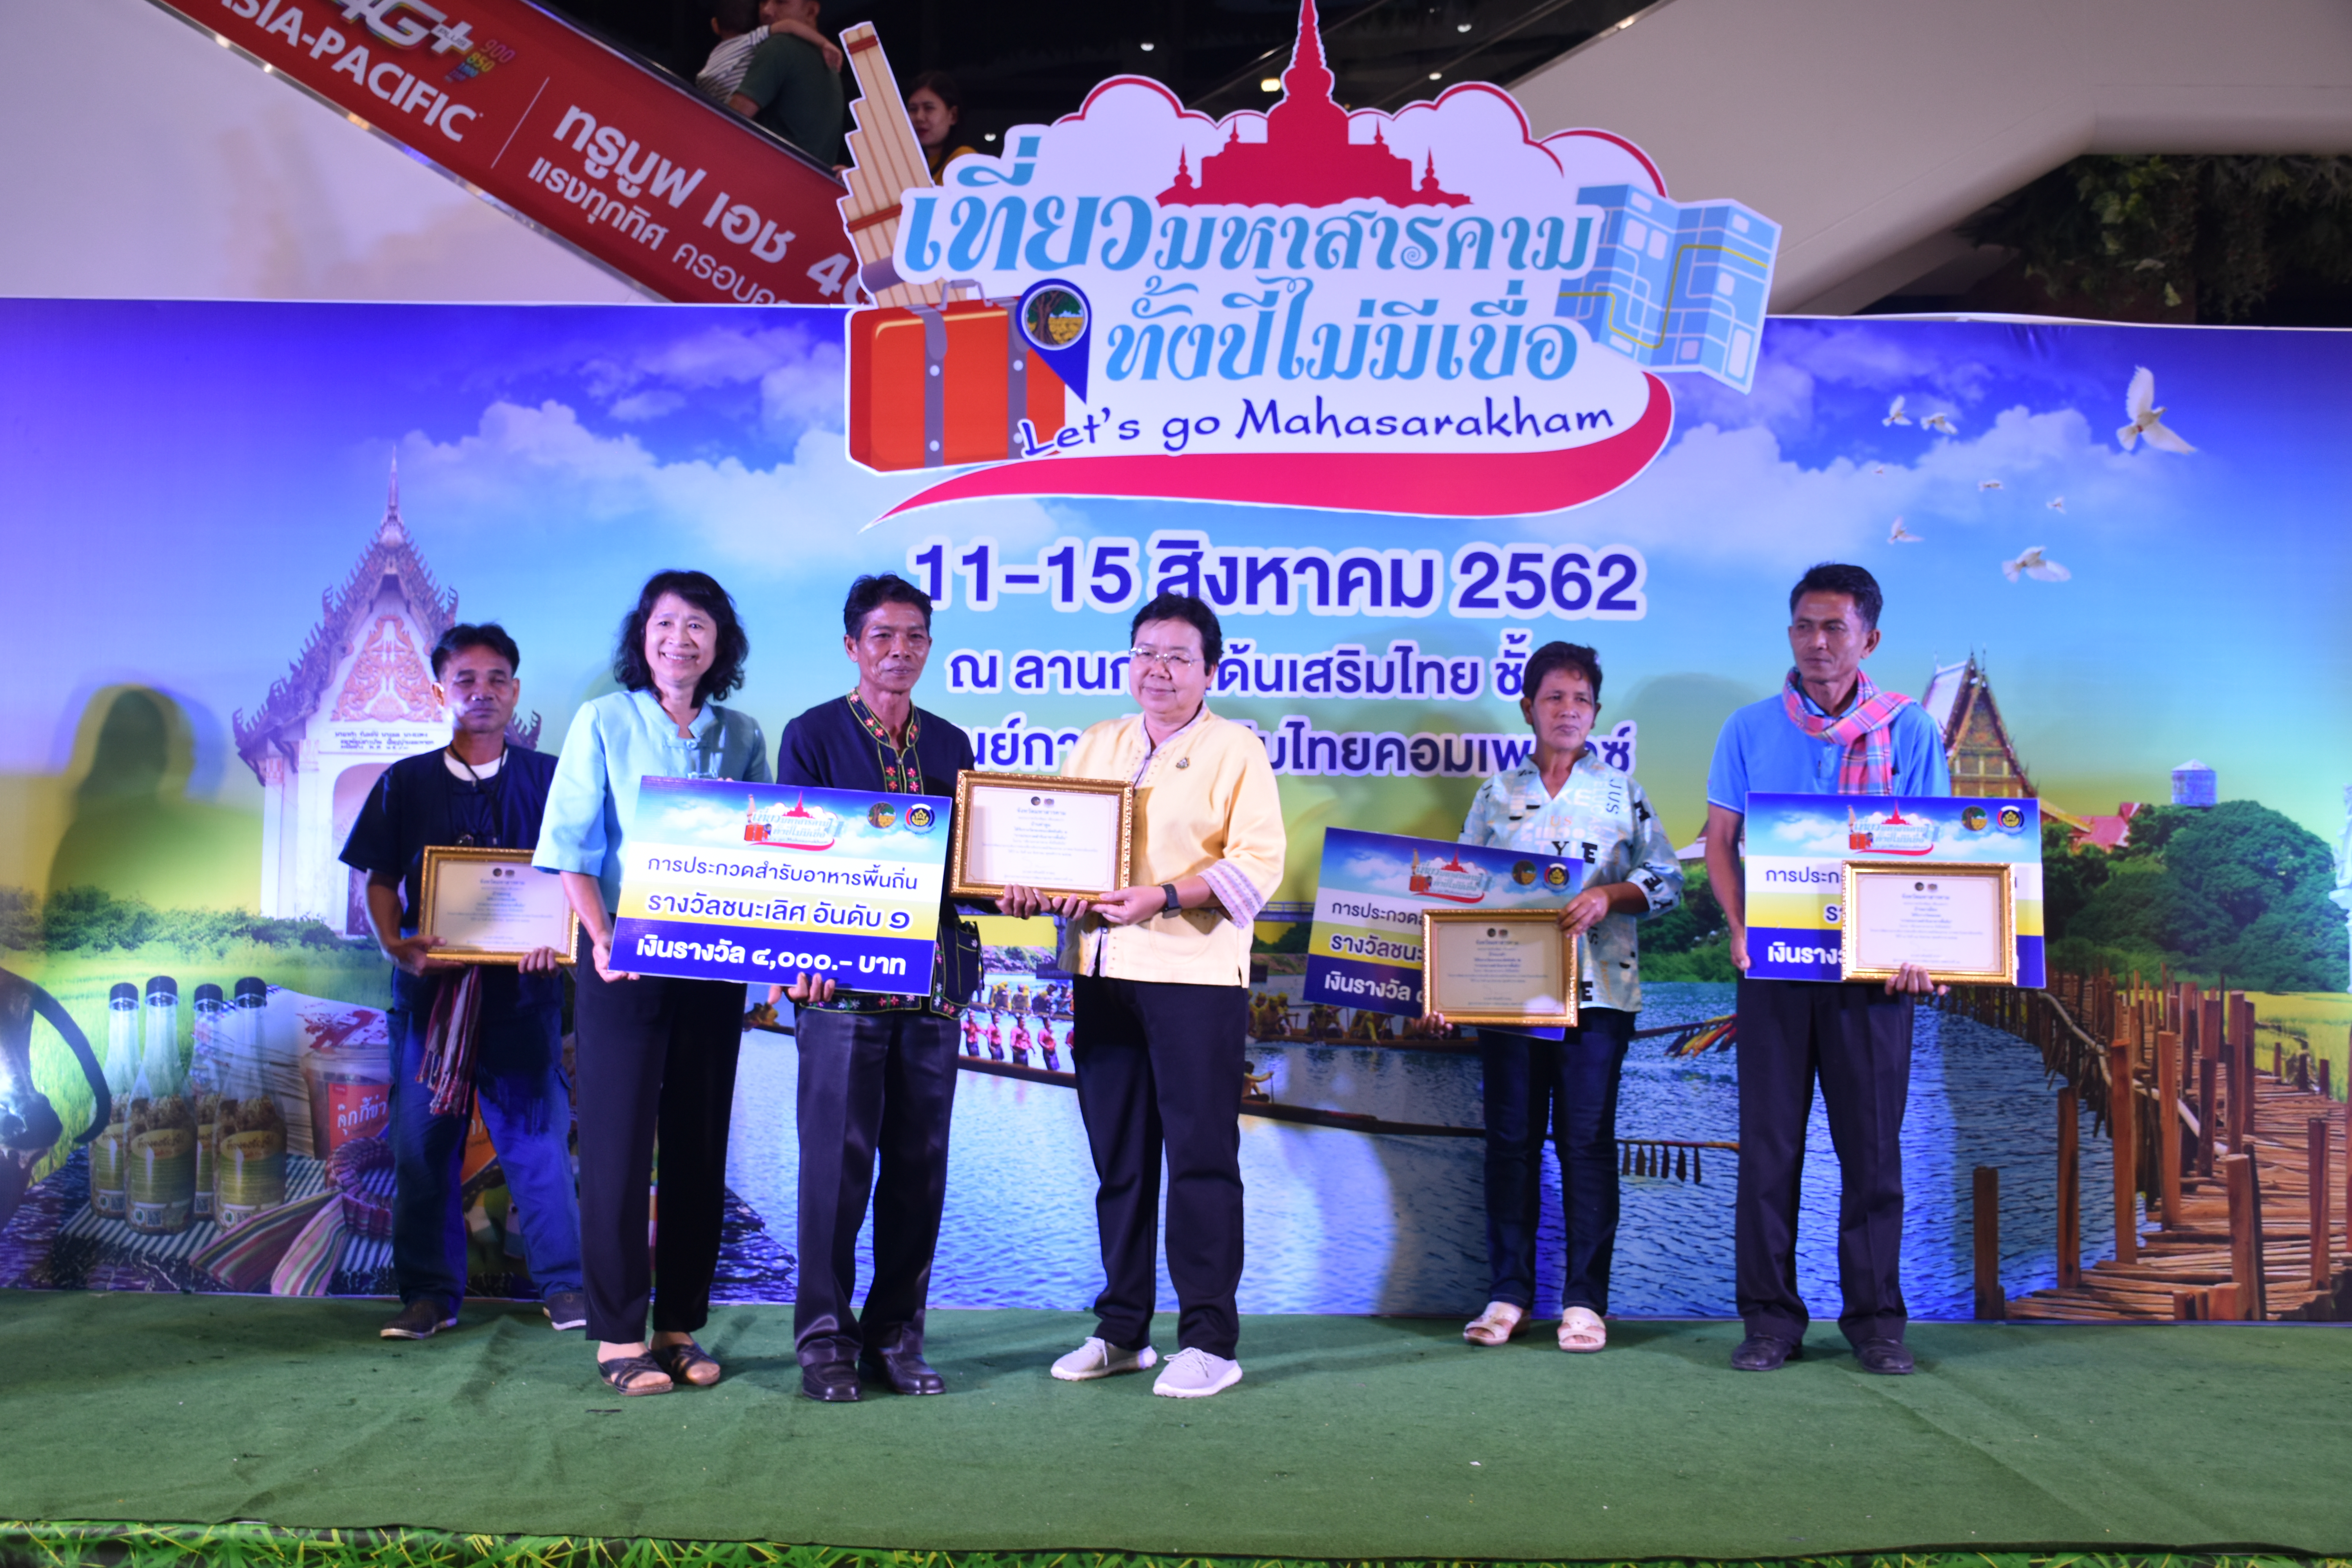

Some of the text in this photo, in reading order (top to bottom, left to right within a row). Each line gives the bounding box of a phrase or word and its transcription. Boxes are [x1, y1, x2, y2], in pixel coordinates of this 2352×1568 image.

[466, 52, 495, 72] 850
[479, 40, 516, 63] 900
[221, 0, 476, 142] SIA-PACIFIC
[553, 105, 706, 209] ทรูมูฟ
[702, 192, 796, 263] เอช
[528, 156, 792, 304] แรงทุกทิศ ครอบค
[1105, 275, 1579, 381] ทั้งปีไม่มีเบื่อ
[1161, 416, 1221, 452] go
[1235, 395, 1615, 439] Mahasarakham
[1156, 539, 1433, 608] สิงหาคม
[1459, 551, 1637, 611] 2562
[950, 655, 997, 688] ณ
[648, 856, 918, 890] การประกวดสำรับอาหารพื้นถิ่น
[1766, 867, 1842, 883] การประก
[648, 892, 806, 922] รางวัลชนะเลิศ
[813, 902, 881, 927] อันดับ
[1332, 902, 1423, 926] การประกวด
[637, 934, 745, 964] เงินรางวัล
[859, 955, 906, 975] บาท
[1324, 970, 1411, 1001] เงินรางวัล
